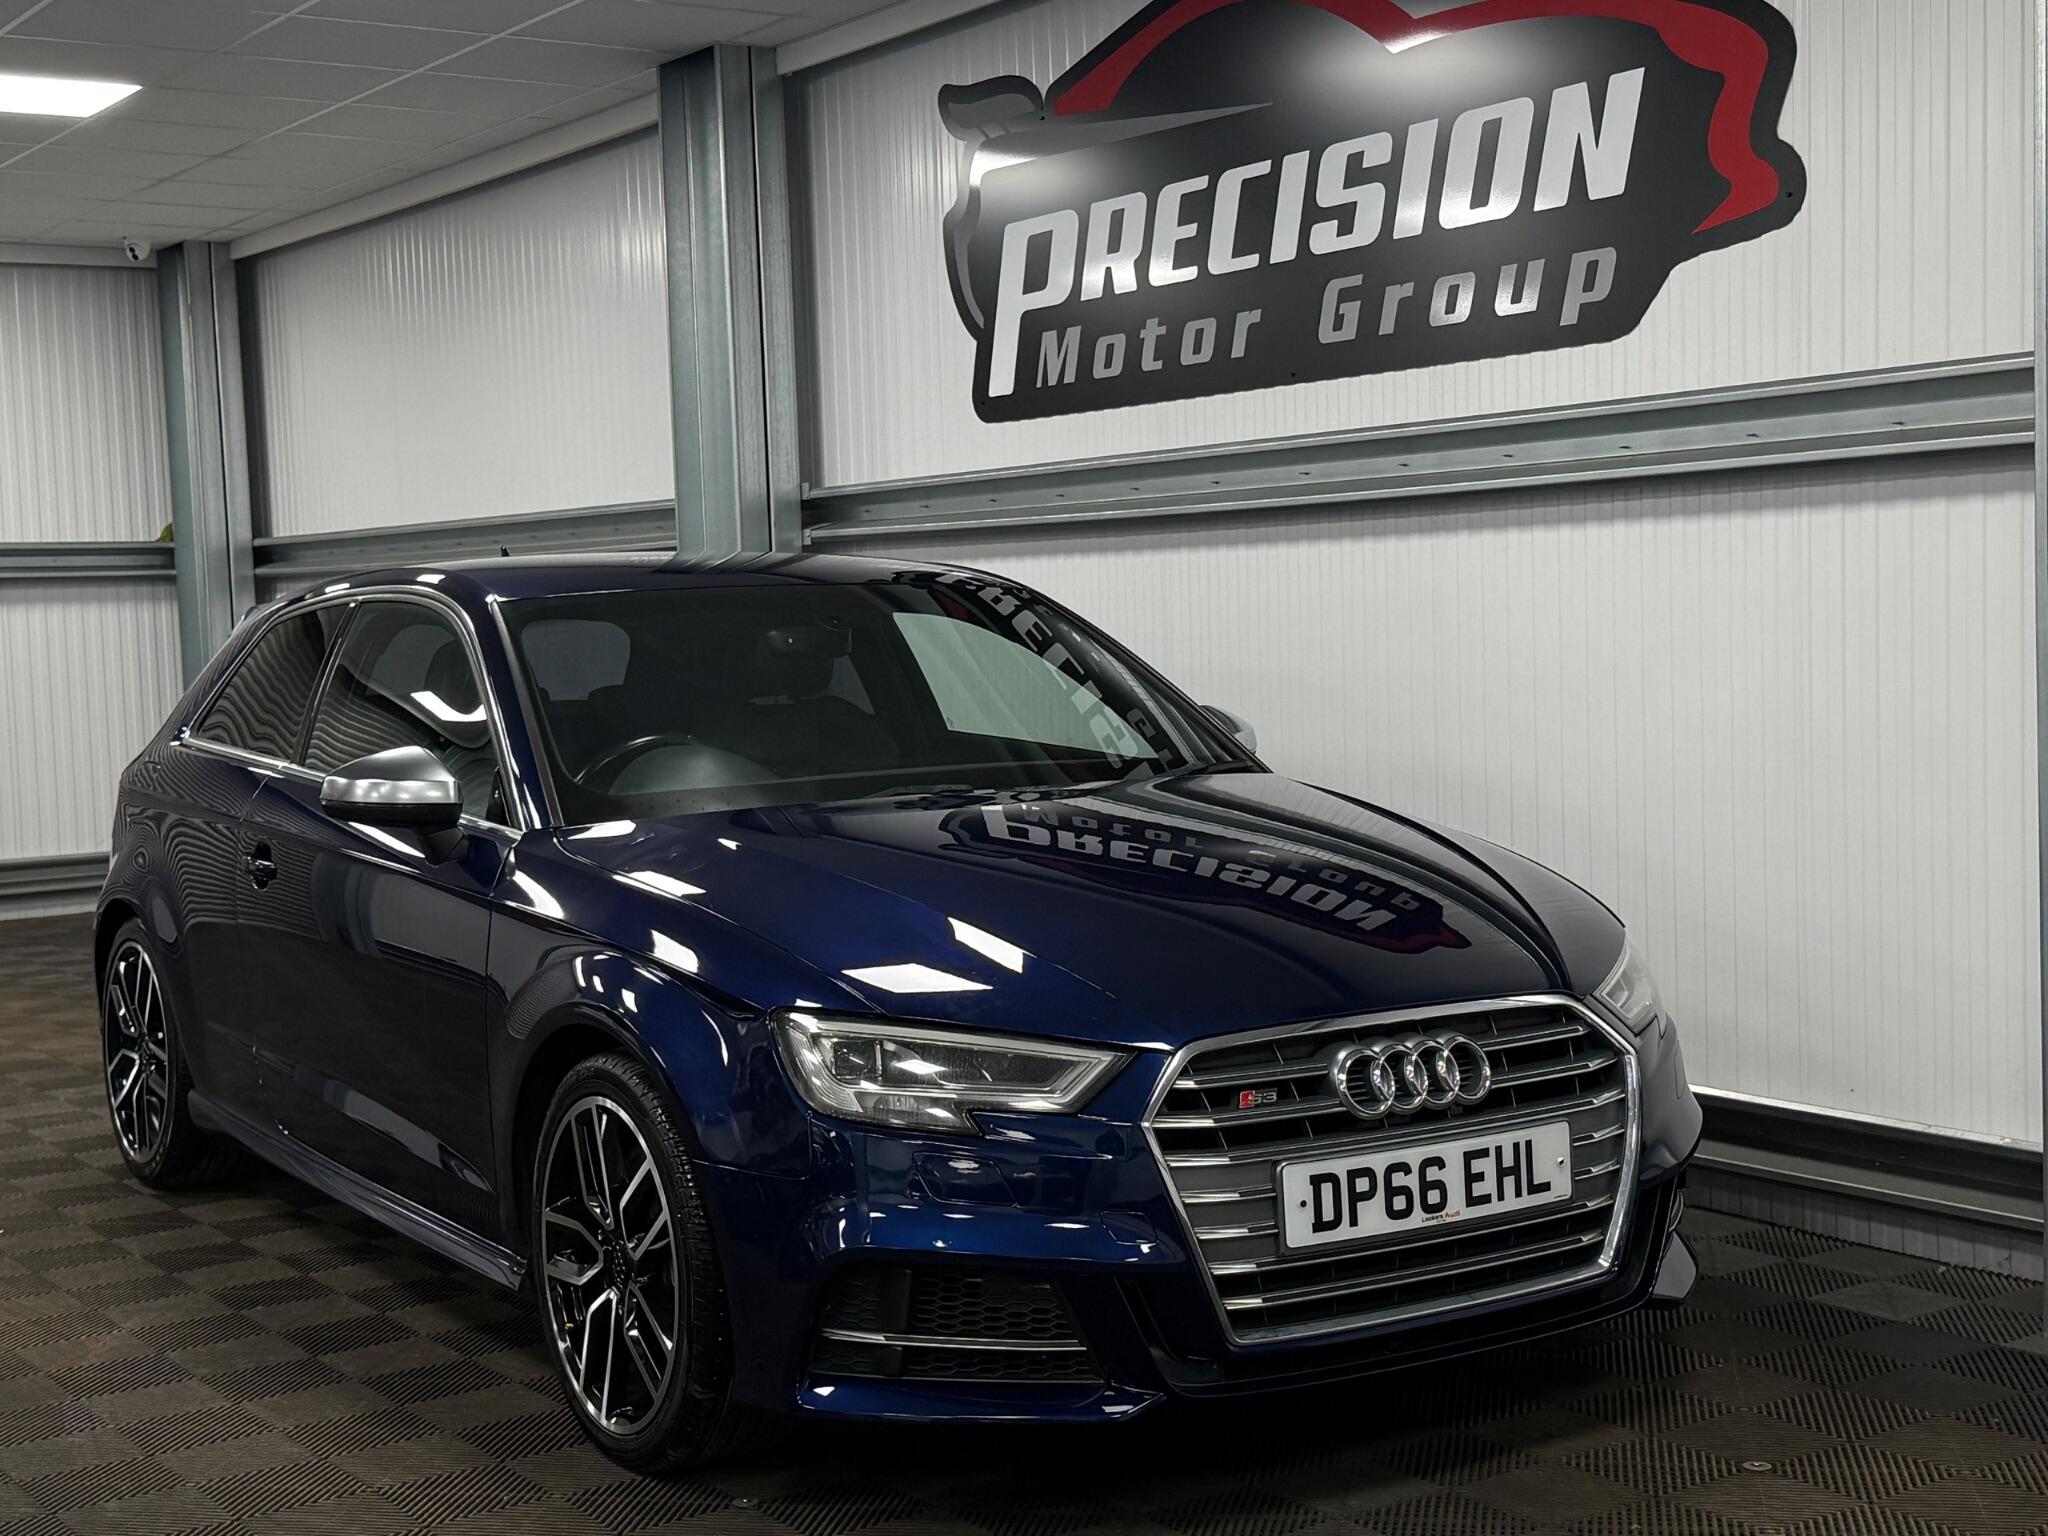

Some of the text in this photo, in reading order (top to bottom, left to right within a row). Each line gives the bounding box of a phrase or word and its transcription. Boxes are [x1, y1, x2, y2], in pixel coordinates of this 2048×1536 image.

[988, 67, 1646, 397] PRECISION
[1036, 246, 1618, 389] Motor Group
[1245, 1091, 1278, 1107] S3
[1310, 1139, 1551, 1234] DP66 EHL
